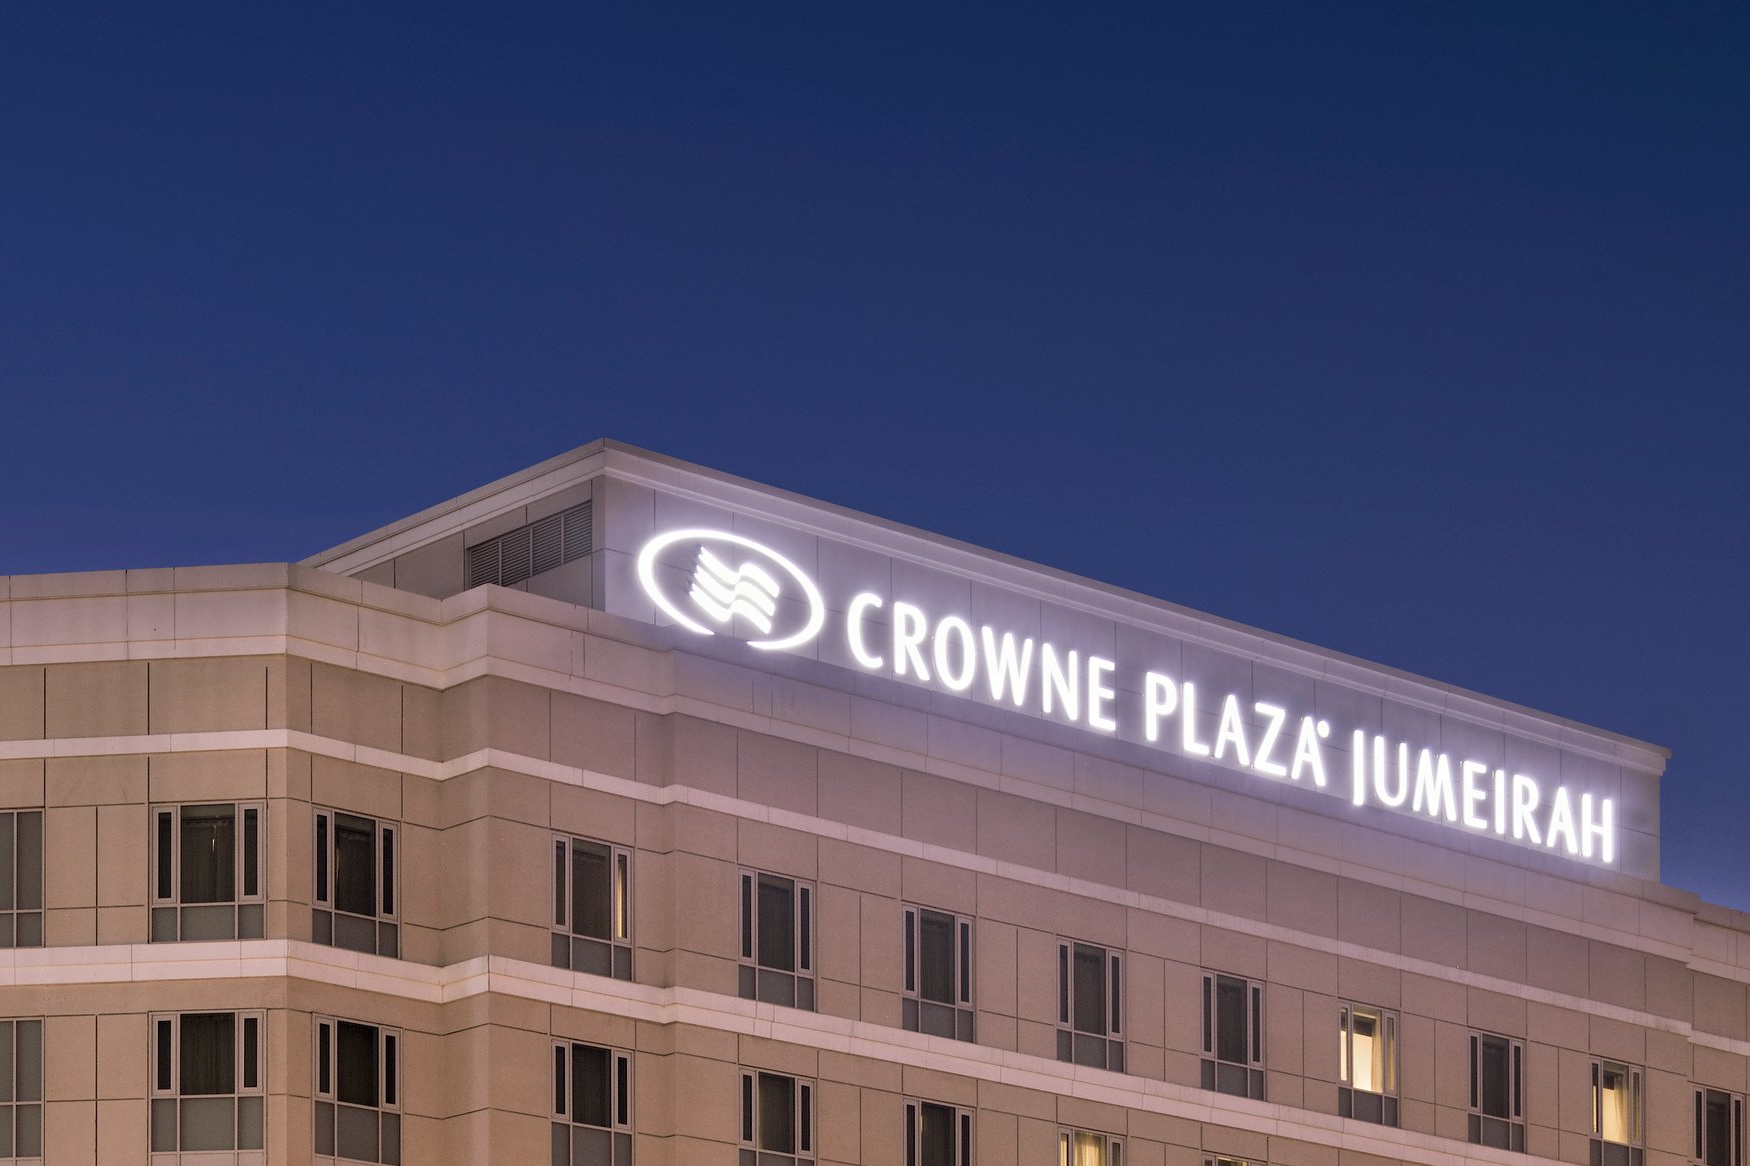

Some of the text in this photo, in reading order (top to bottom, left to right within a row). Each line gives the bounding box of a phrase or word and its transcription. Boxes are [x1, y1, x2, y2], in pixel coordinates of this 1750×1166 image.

[847, 592, 1614, 863] CROWNE PLAZA JUMEIRAH
